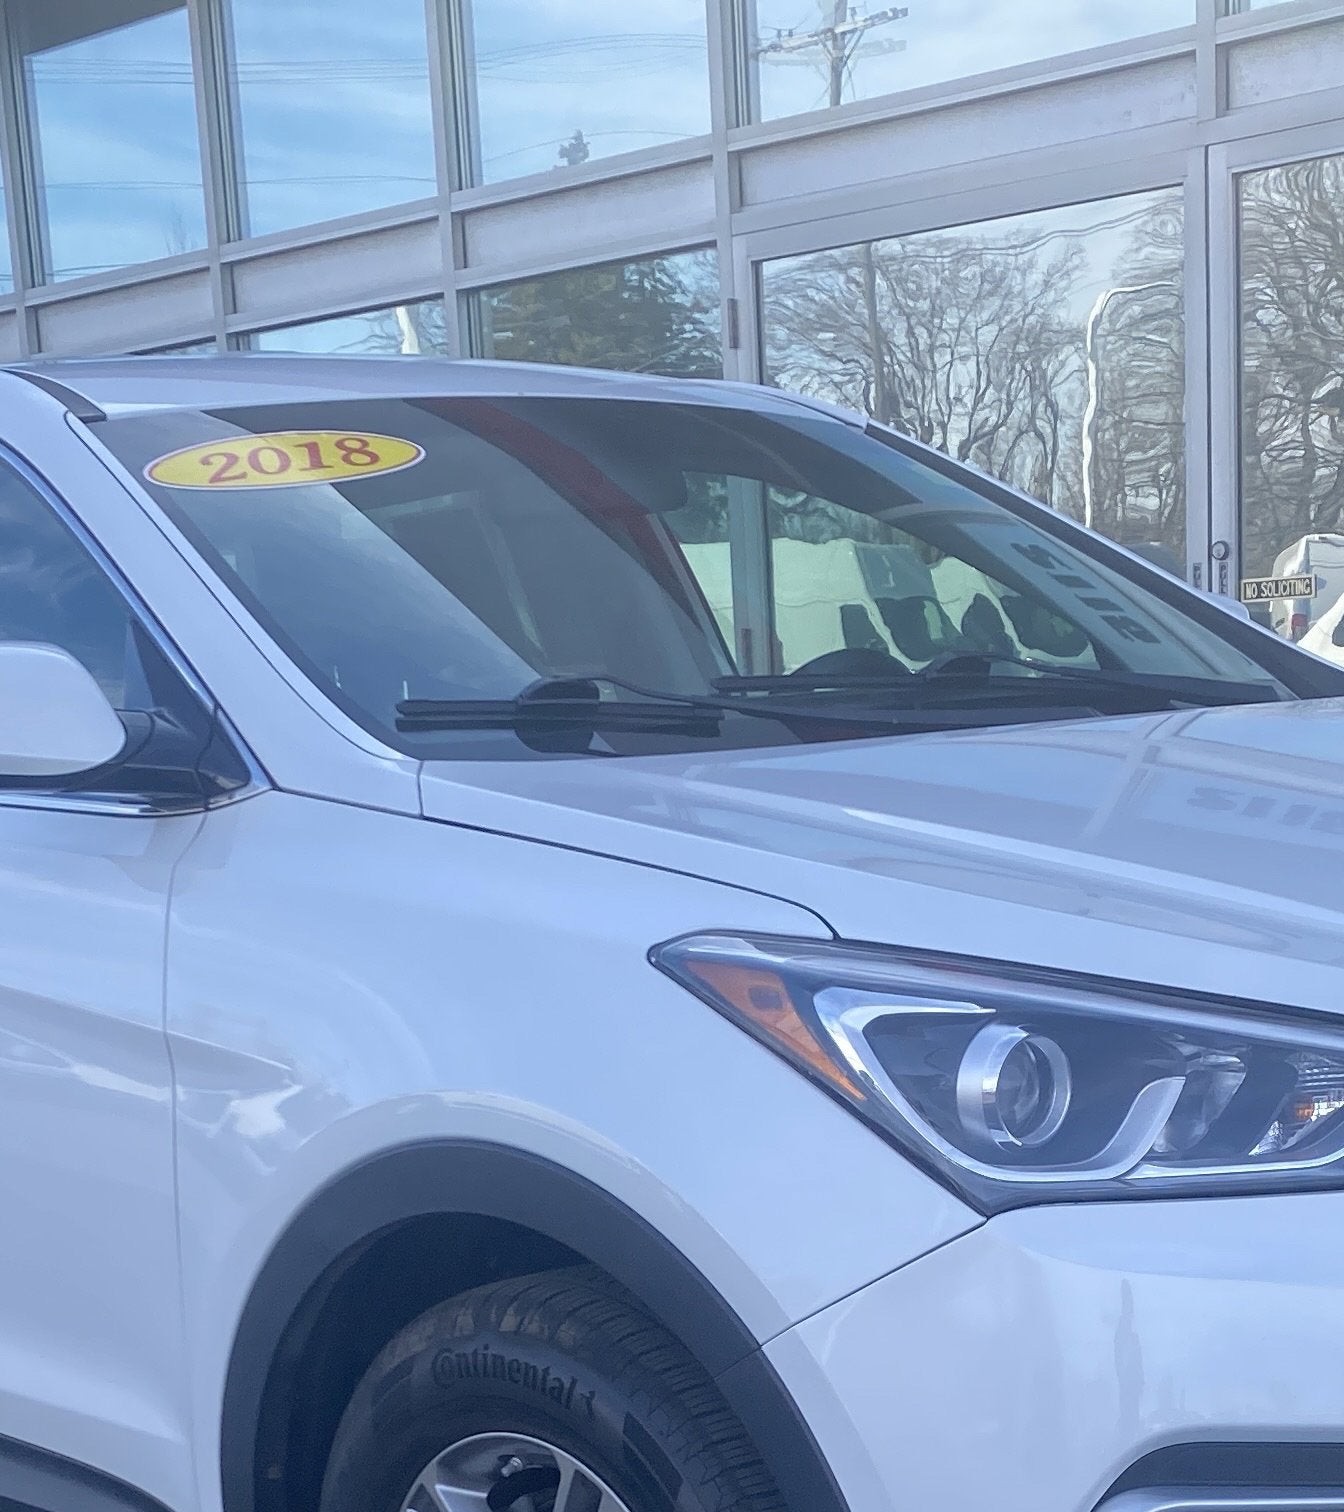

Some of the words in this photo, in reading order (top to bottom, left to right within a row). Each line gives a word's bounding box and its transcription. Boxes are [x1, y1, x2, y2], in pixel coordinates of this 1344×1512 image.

[199, 437, 381, 485] 2018
[1245, 583, 1258, 599] NO
[1260, 578, 1311, 598] SOLICITING
[431, 1343, 579, 1410] Continental
